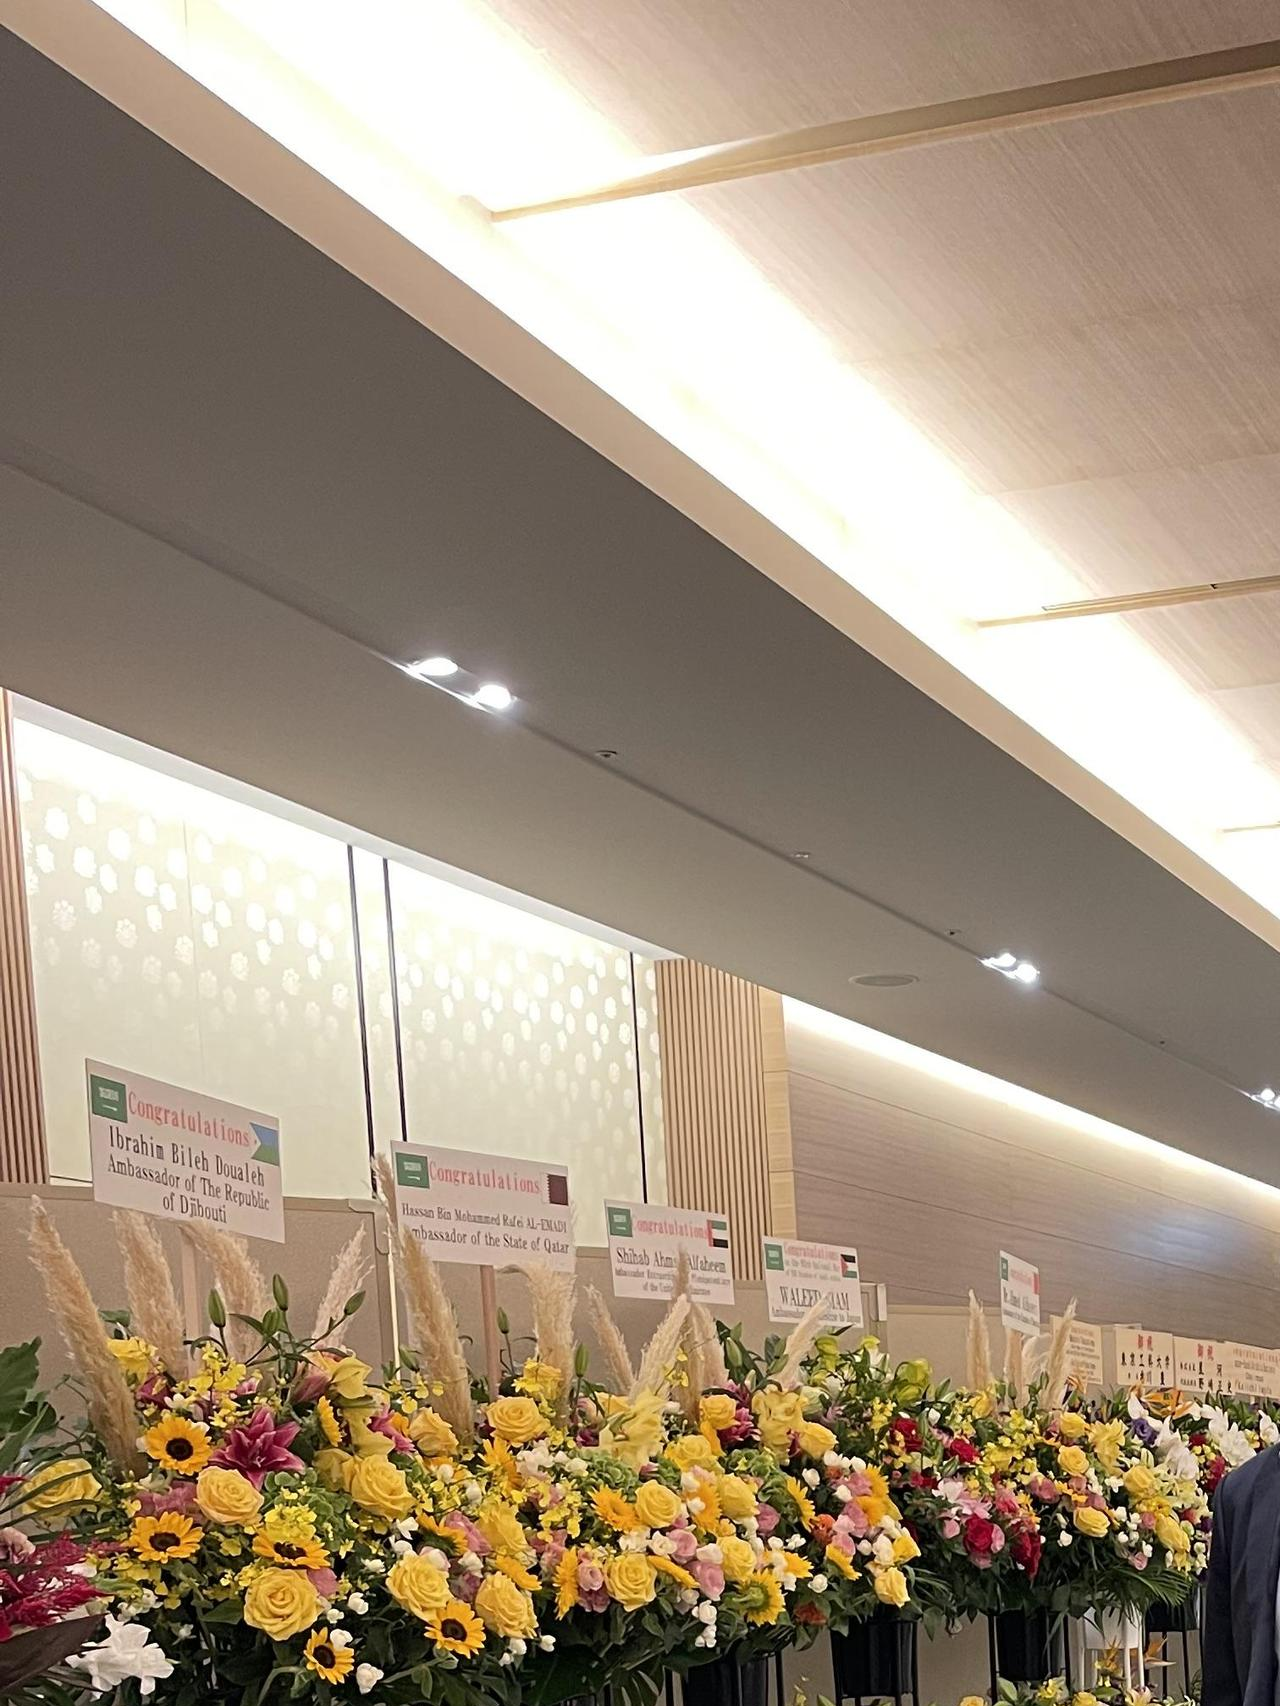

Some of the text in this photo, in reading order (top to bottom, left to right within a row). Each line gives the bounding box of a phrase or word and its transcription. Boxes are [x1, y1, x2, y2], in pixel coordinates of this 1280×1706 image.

[128, 1090, 250, 1147] Congratulations
[109, 1125, 265, 1187] Ibrahim Bileh Doualeh
[108, 1154, 269, 1211] Ambassador of The Republic
[429, 1160, 540, 1194] Congratulations
[163, 1193, 227, 1224] of Djibouti
[402, 1203, 435, 1219] Hassan
[437, 1206, 451, 1220] Bin
[412, 1225, 569, 1254] mbassador of the State of Qatar
